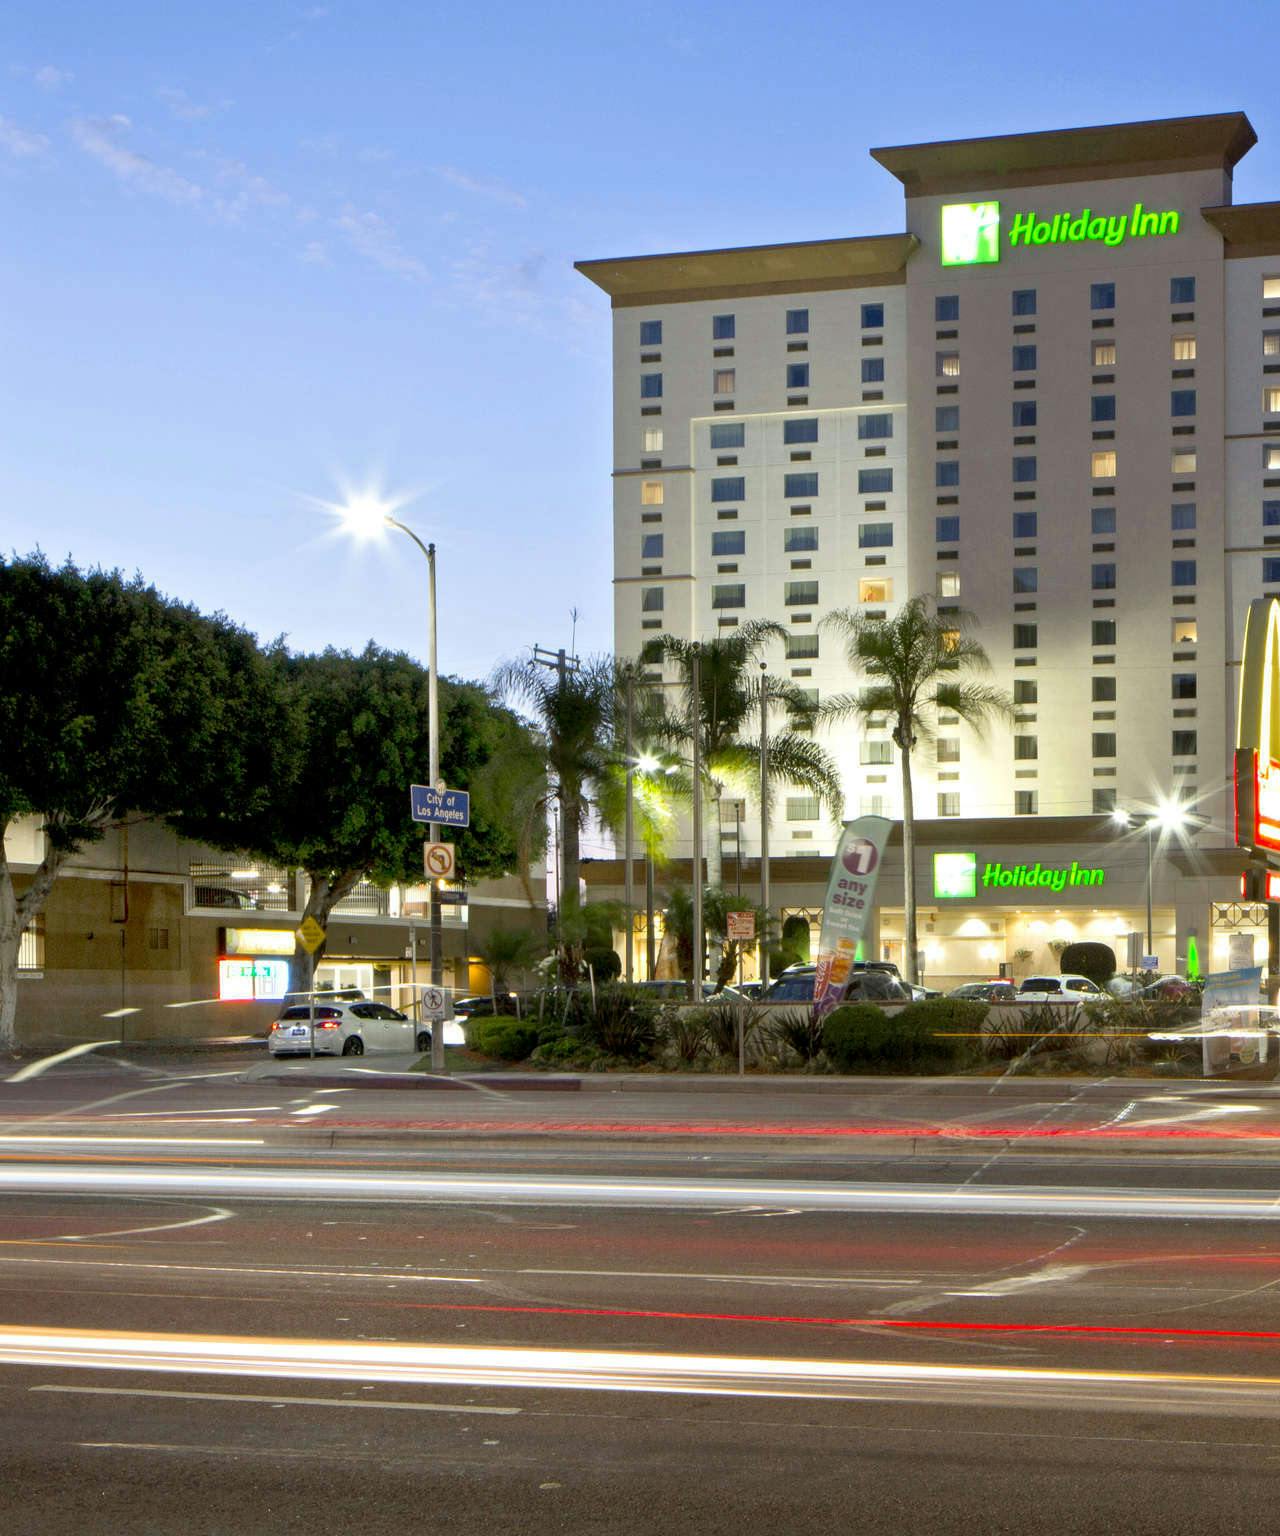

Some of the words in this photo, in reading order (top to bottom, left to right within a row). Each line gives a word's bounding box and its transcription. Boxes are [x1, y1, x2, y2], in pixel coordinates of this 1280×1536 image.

[1009, 208, 1127, 247] Holiday
[1130, 203, 1180, 237] Inn
[426, 793, 443, 806] City
[446, 796, 455, 806] of
[417, 804, 431, 816] Los
[434, 808, 464, 822] Angeles
[982, 862, 1068, 892] Holiday
[1069, 861, 1105, 886] Inn
[837, 878, 868, 896] any
[832, 891, 865, 910] size
